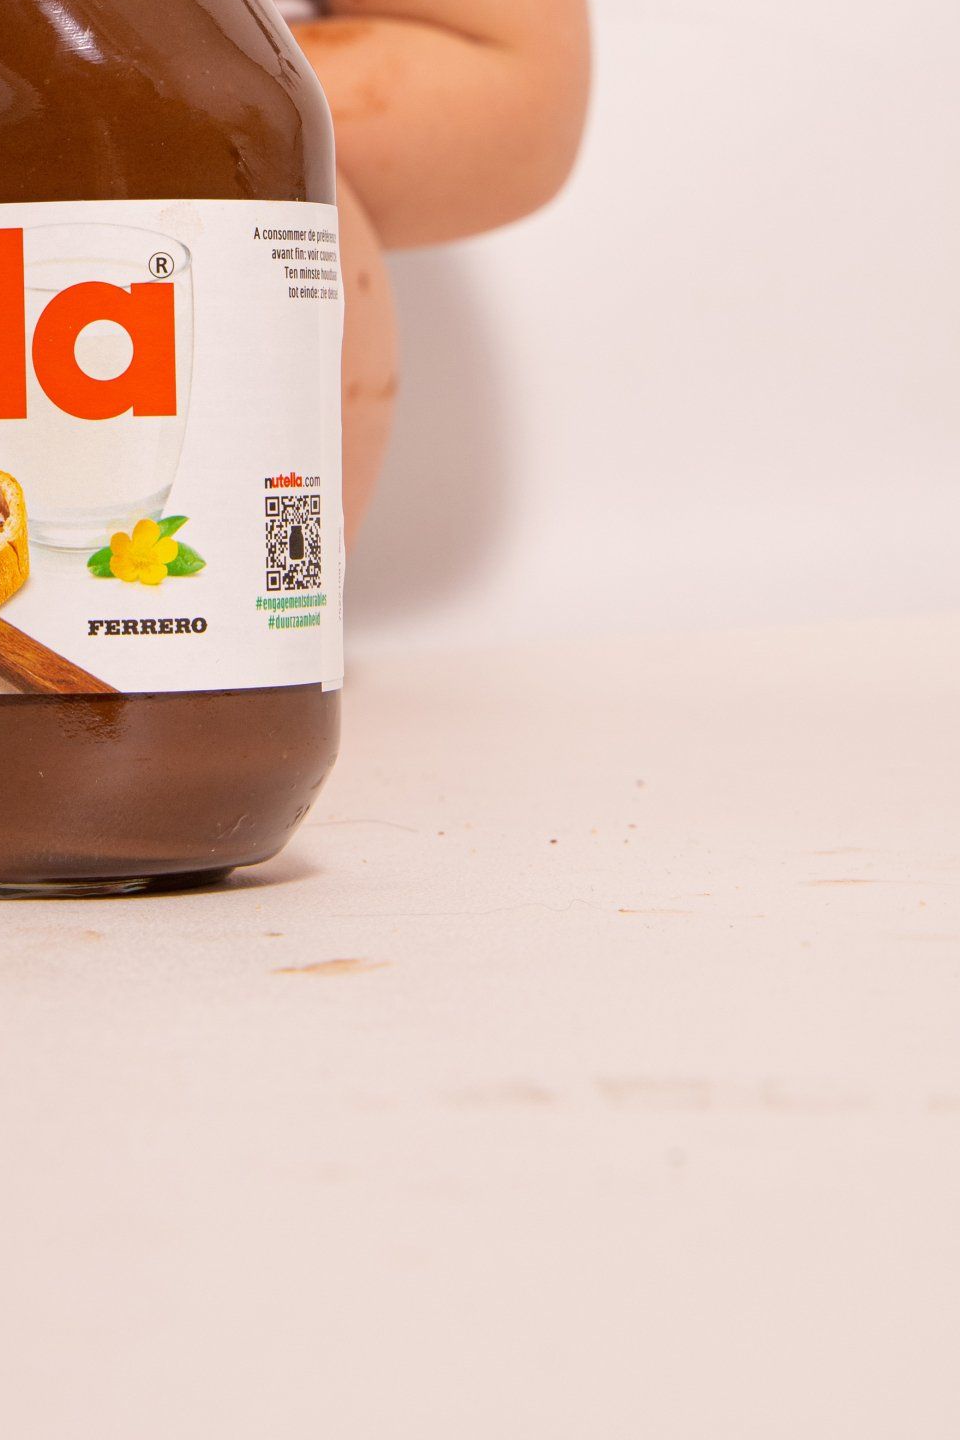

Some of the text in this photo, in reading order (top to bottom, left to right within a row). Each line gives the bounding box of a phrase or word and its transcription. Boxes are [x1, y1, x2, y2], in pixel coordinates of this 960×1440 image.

[253, 227, 261, 240] A
[262, 229, 307, 241] consommer
[307, 229, 316, 242] de
[271, 248, 294, 260] avant
[295, 247, 307, 260] fin:
[307, 249, 319, 261] voir
[284, 266, 299, 279] Ten
[299, 267, 321, 280] minste
[288, 286, 299, 299] tot
[300, 286, 320, 299] einde:
[320, 287, 328, 299] zie
[264, 471, 321, 489] nutella.com
[255, 593, 327, 612] #engagementsdurables
[87, 617, 208, 636] FERRERO
[268, 612, 321, 629] #duurzaamheid
